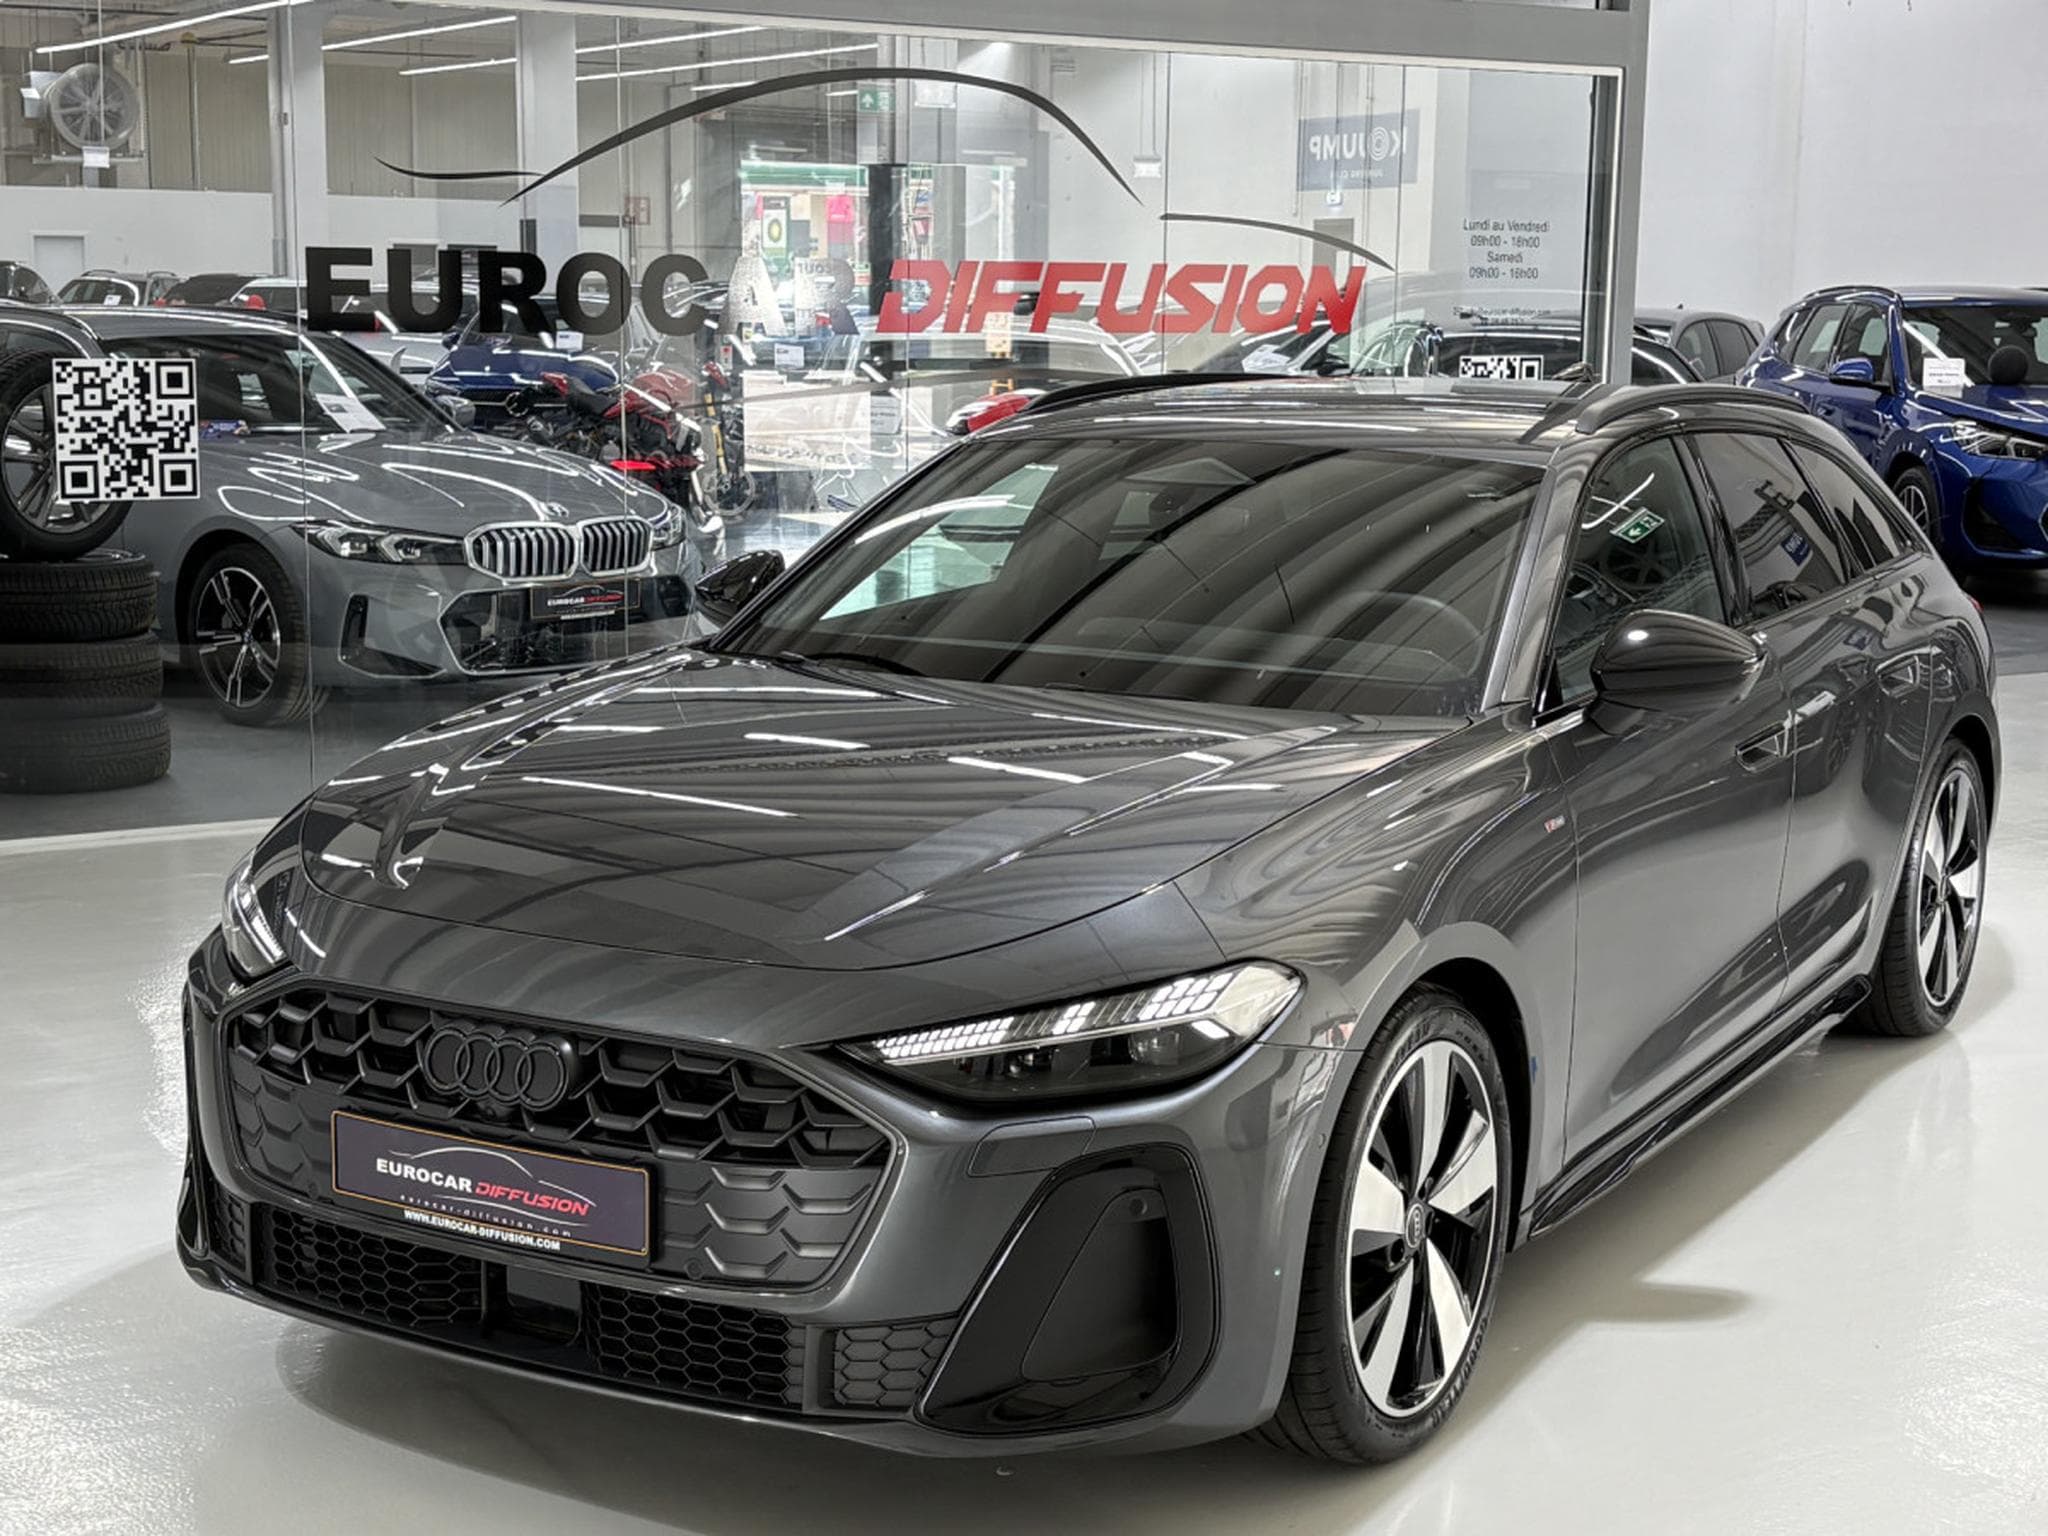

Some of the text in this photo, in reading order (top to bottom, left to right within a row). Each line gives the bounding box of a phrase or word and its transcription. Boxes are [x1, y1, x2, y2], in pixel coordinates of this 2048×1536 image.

[1463, 219, 1490, 231] Lundi
[1492, 221, 1504, 231] au
[305, 246, 1366, 336] EUROCAR DIFFUSION
[376, 1157, 590, 1217] EUROCAR DIFFUSION
[403, 1208, 561, 1252] WWW.EUROCAR-DIFFUSION.COM
